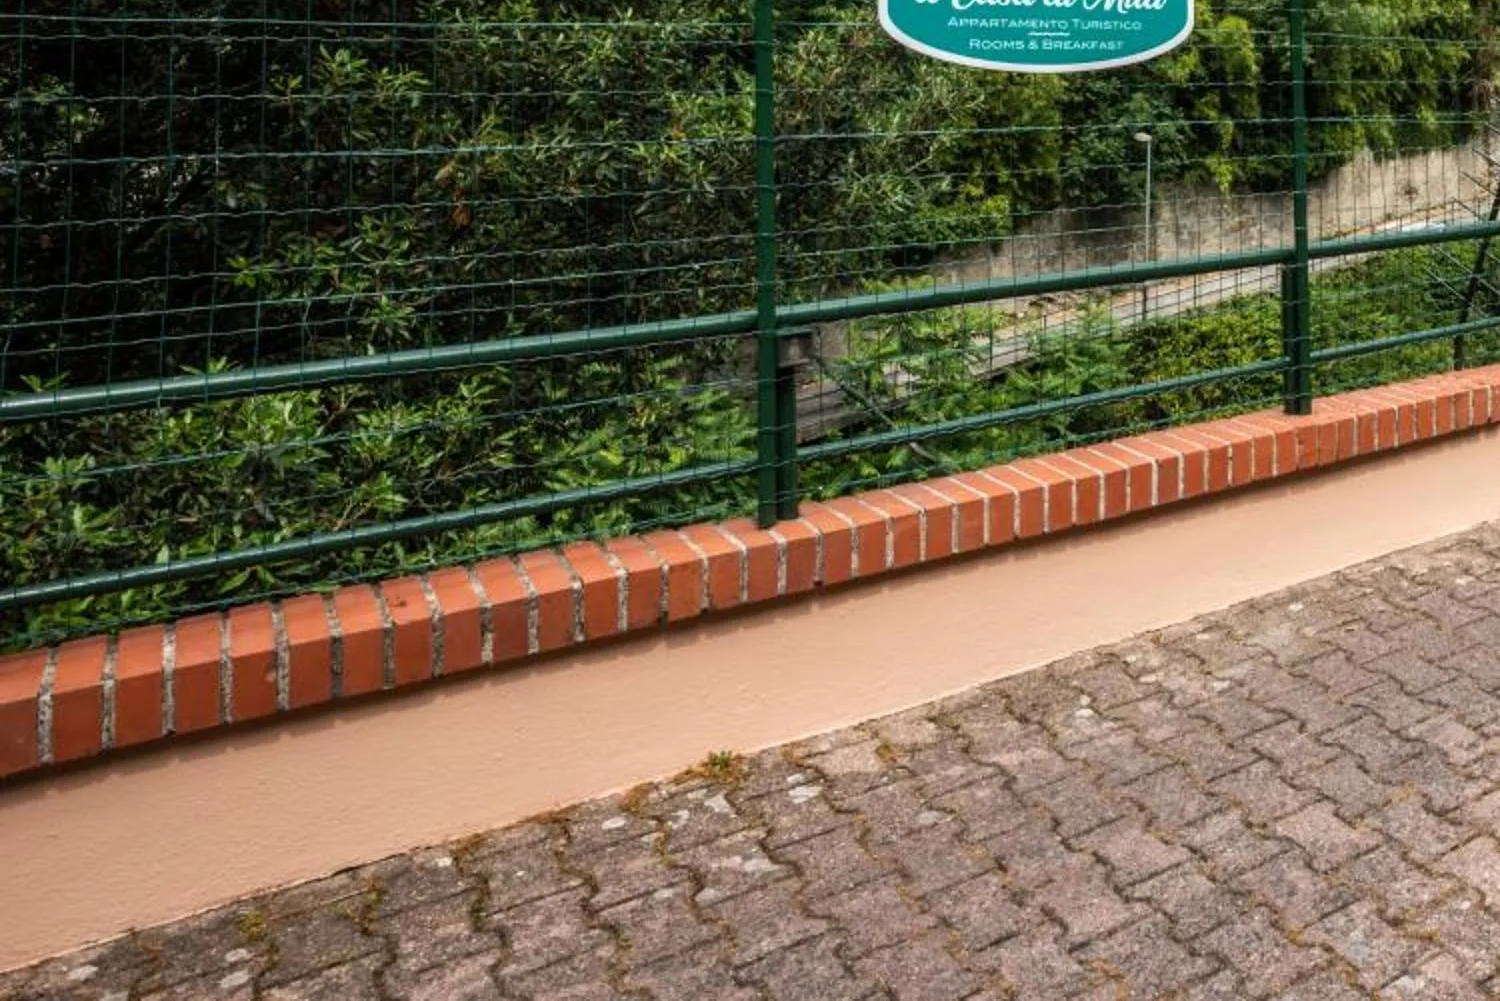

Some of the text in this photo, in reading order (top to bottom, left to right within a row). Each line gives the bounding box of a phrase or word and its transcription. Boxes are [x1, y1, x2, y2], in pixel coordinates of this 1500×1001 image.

[947, 16, 1143, 31] APPARTAMENTO TURISTICO
[968, 38, 1126, 51] ROOMS & BREAKFAST
